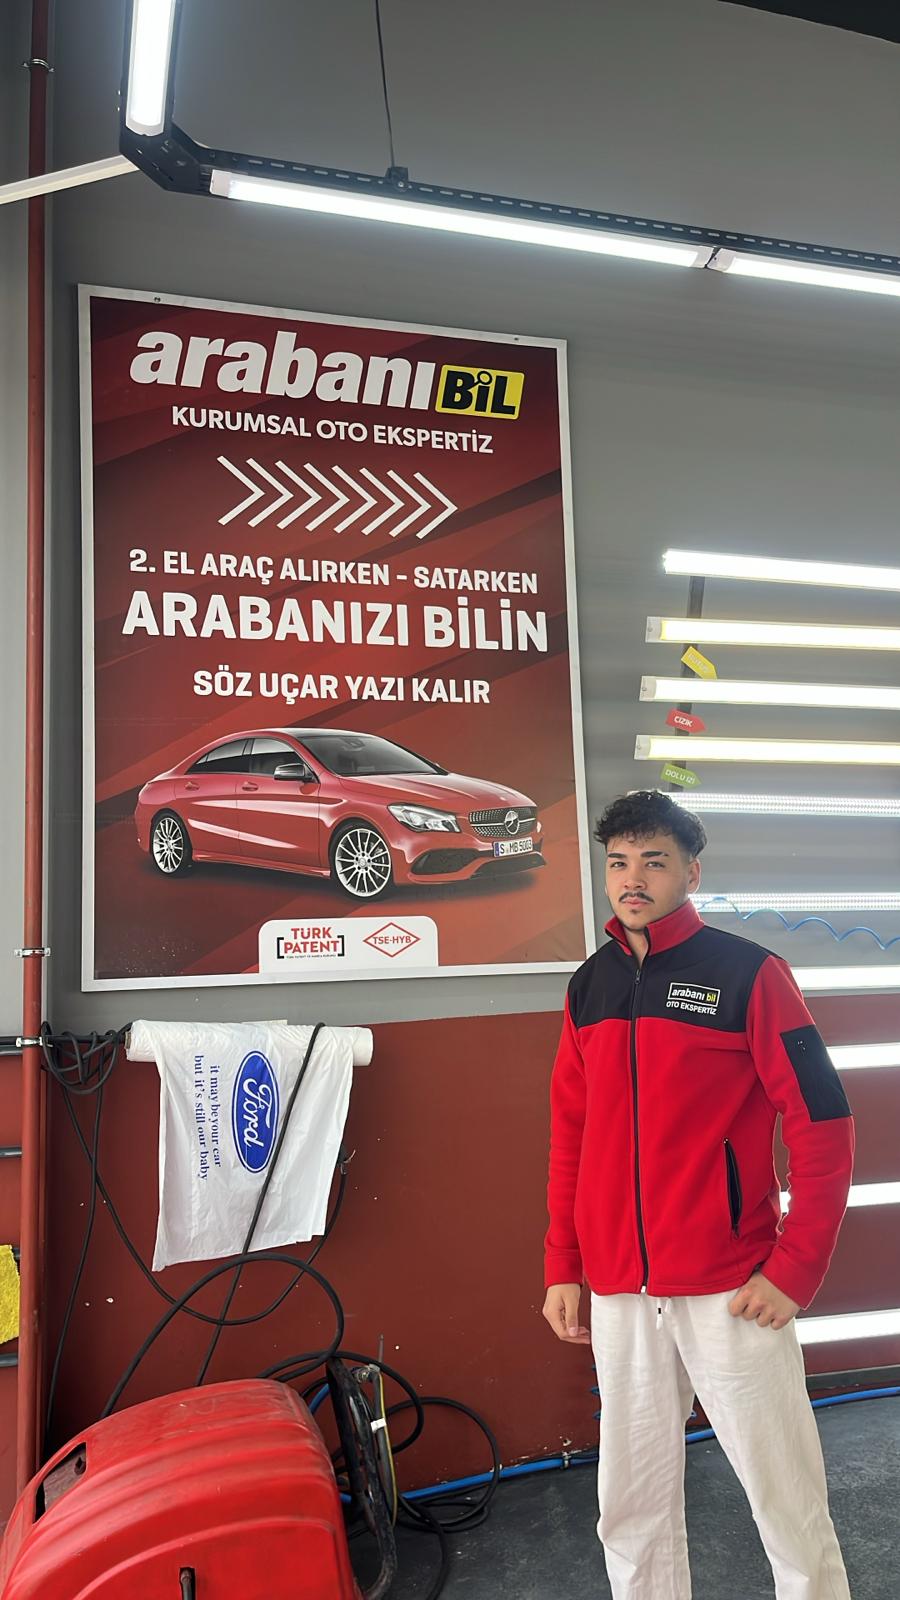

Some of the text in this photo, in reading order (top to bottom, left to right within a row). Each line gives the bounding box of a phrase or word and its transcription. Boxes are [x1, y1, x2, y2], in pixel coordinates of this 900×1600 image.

[129, 331, 435, 411] arabanı
[172, 406, 494, 454] KURUMSAL OTO EKSPERTİZ
[129, 549, 156, 573] 2.
[163, 551, 195, 575] EL
[200, 553, 274, 586] ARAÇ
[279, 558, 390, 586] ALIRKEN
[413, 566, 538, 595] SATARKEN
[121, 590, 548, 653] ARABANIZI BİLİN
[193, 664, 491, 705] SÖZ UÇAR YAZI KALIR
[665, 769, 686, 781] DOLU
[284, 940, 340, 954] PATENT
[373, 936, 412, 945] TSE-HYB
[194, 1055, 204, 1075] but
[210, 1065, 220, 1074] it
[208, 1077, 218, 1101] may
[195, 1102, 206, 1123] still
[243, 1078, 272, 1147] Ford
[197, 1126, 206, 1147] our
[197, 1151, 209, 1180] baby
[212, 1148, 221, 1168] car
